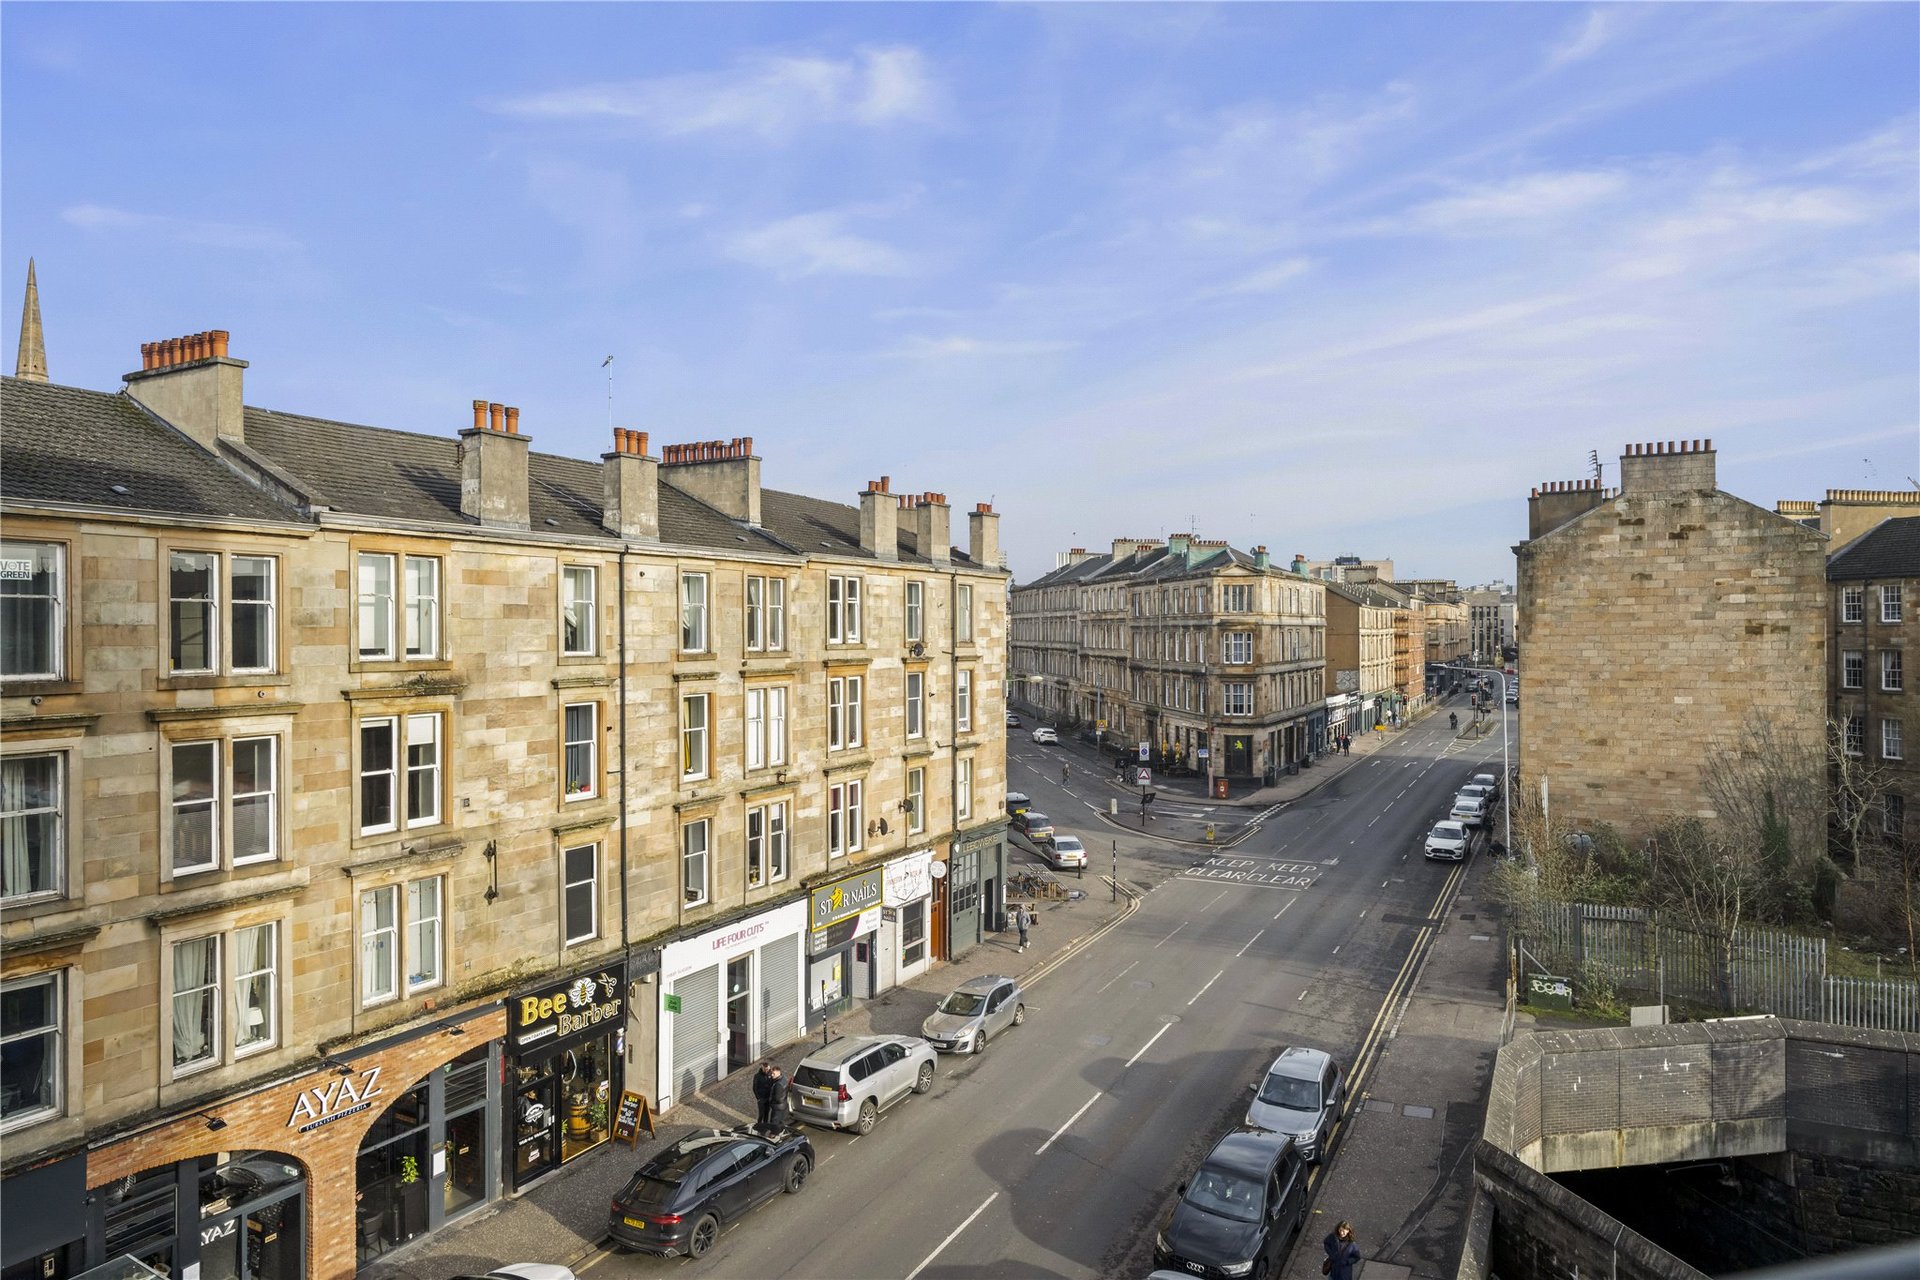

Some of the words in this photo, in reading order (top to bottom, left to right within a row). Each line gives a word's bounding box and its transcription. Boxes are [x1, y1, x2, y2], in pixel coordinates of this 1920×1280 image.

[0, 561, 31, 571] VOTE
[0, 570, 30, 579] GREEN
[1205, 857, 1255, 868] KEEP
[1267, 862, 1317, 874] KEEP
[1185, 867, 1247, 880] CLEAR
[1247, 873, 1311, 886] CLEAR
[850, 881, 877, 905] NAILS
[712, 936, 727, 950] LIFE
[727, 929, 747, 944] FOUR
[746, 923, 765, 937] CUTS
[521, 992, 567, 1027] Bee
[558, 999, 622, 1037] Barber
[286, 1066, 383, 1127] AYAZ
[306, 1116, 336, 1132] TURKISH
[337, 1103, 368, 1120] PIZZERIA
